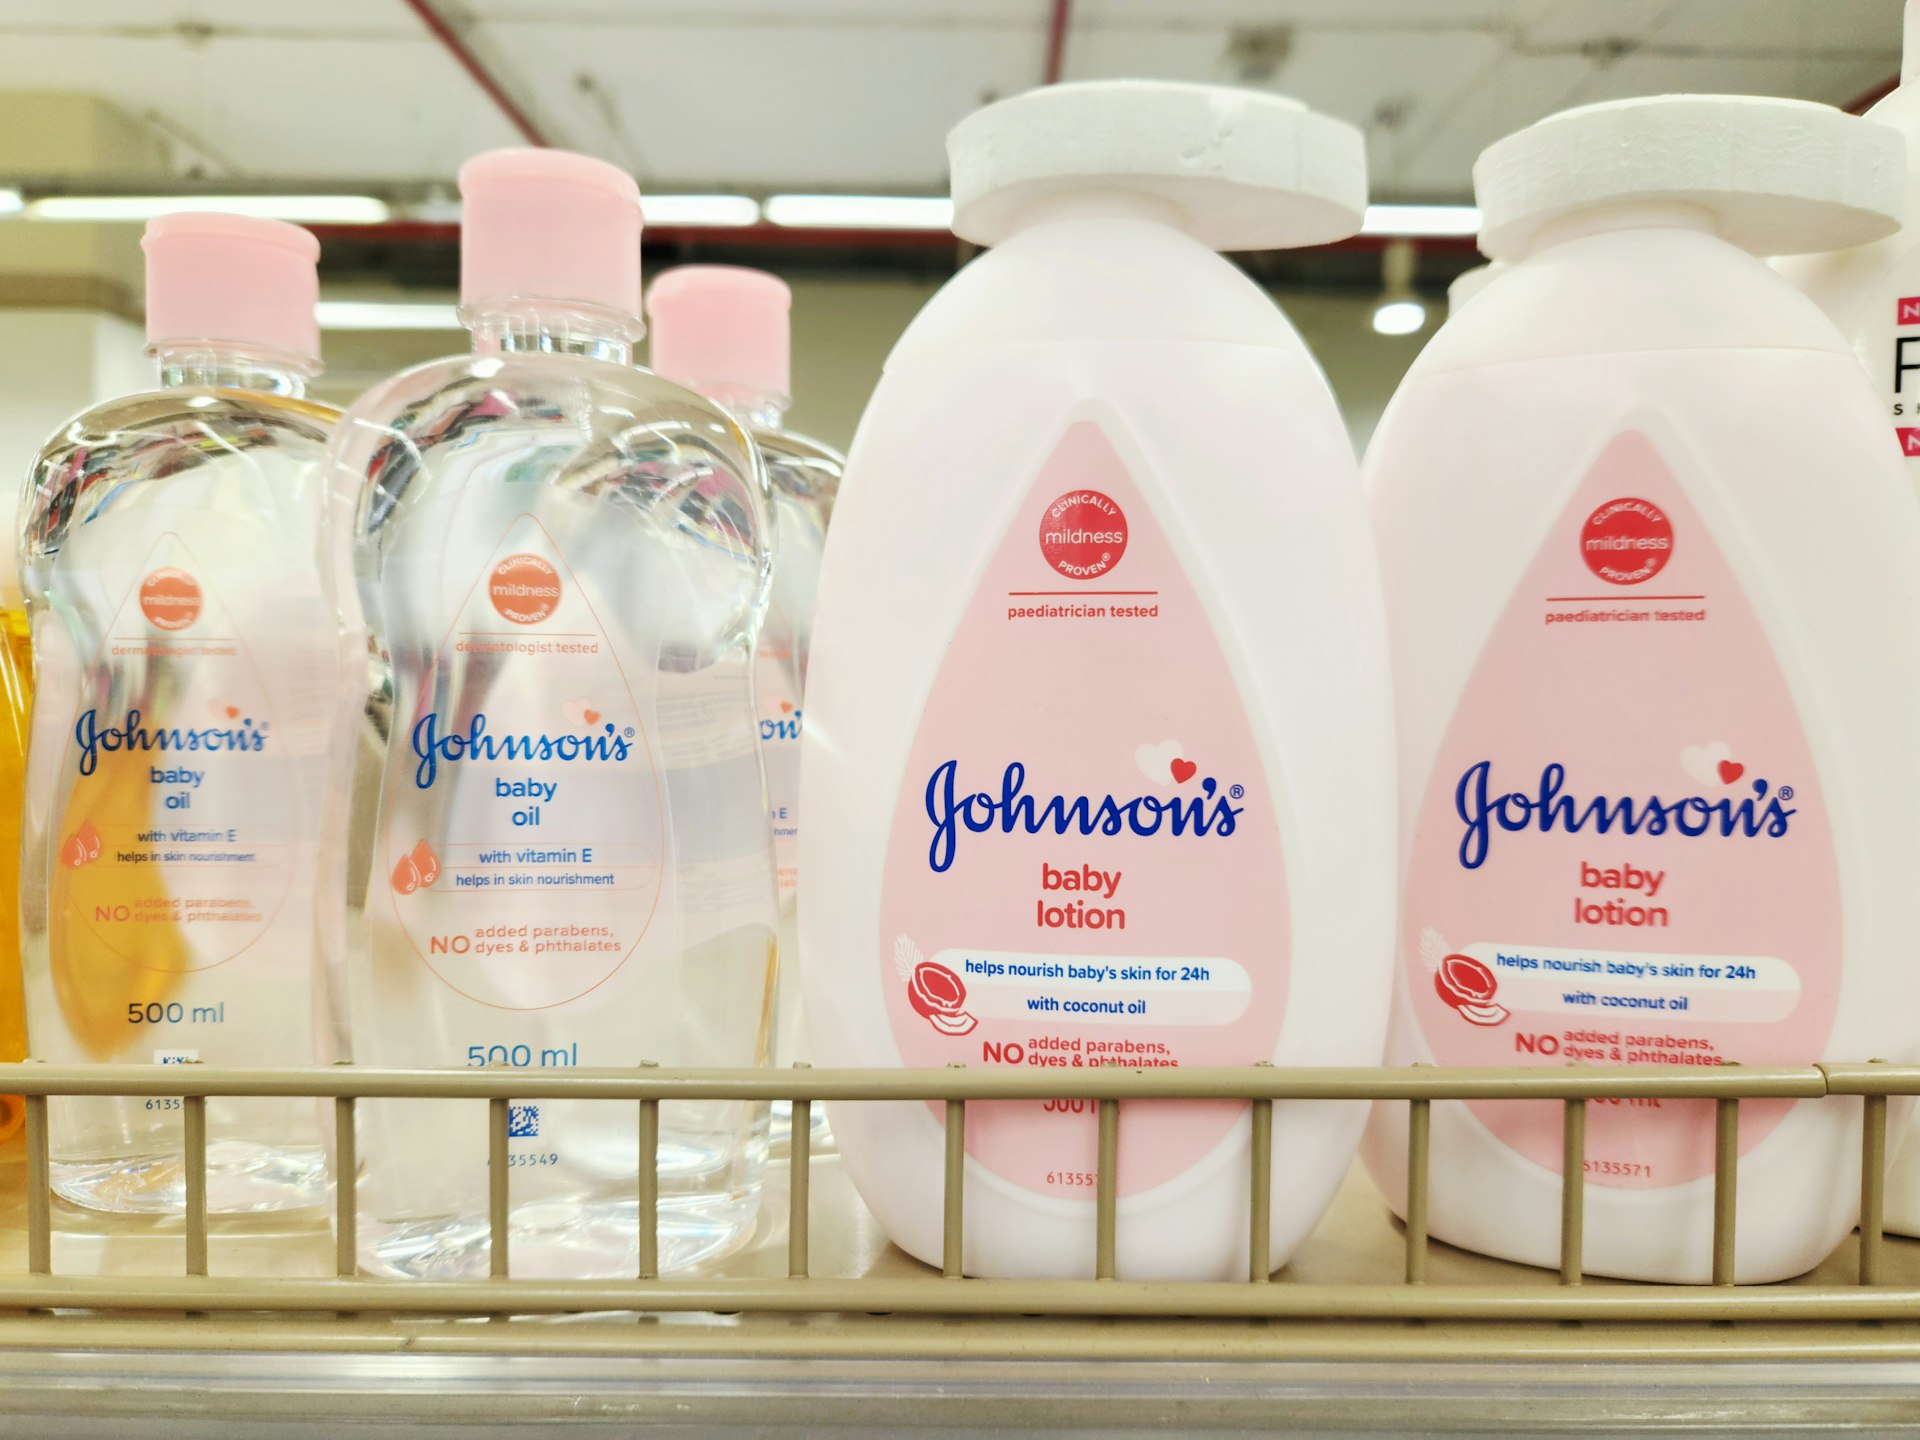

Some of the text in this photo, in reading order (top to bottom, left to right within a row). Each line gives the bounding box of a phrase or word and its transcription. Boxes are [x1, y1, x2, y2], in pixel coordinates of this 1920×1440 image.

[1051, 494, 1117, 518] CLINICALLY
[1592, 502, 1663, 526] CLINICALLY
[1045, 529, 1123, 544] mildness
[1586, 535, 1669, 551] mildness
[498, 556, 553, 576] CLINICALLY
[493, 584, 559, 598] mildness
[1007, 604, 1159, 620] paediatrician tested
[1545, 610, 1705, 625] paediatrician tested
[456, 641, 598, 655] dermatologist tested
[150, 766, 204, 788] baby
[495, 777, 557, 802] baby
[166, 792, 190, 809] oil
[512, 806, 540, 827] oil
[137, 830, 237, 842] with vitamin E
[117, 852, 256, 863] helps in skin nourishment
[479, 848, 592, 863] with vitamin E
[456, 873, 615, 888] helps in skin nourishment
[1042, 863, 1122, 898] baby
[1580, 861, 1665, 896] baby
[134, 898, 181, 908] added
[95, 906, 130, 922] NO
[134, 911, 168, 923] dyes
[173, 911, 182, 921] &
[1037, 900, 1125, 929] lotion
[1574, 898, 1668, 927] lotion
[475, 925, 614, 940] added parabens,
[430, 936, 470, 954] NO
[475, 940, 621, 956] dyes & phthalates
[965, 959, 1210, 982] helps nourish baby's skin for 24h
[1496, 953, 1756, 979] helps nourish baby's skin for 24h
[1027, 997, 1146, 1014] with coconut oil
[1563, 990, 1688, 1010] with coconut oil
[128, 1003, 225, 1023] 500 ml
[1028, 1036, 1171, 1056] added parabens,
[1515, 1032, 1559, 1056] NO
[1563, 1028, 1715, 1052] added parabens,
[468, 1042, 577, 1067] 500 ml
[983, 1041, 1024, 1064] NO
[1028, 1052, 1067, 1067] dyes
[1072, 1054, 1083, 1067] &
[1563, 1045, 1722, 1066] dyes & phthalates
[145, 1099, 184, 1110] 6135
[488, 1153, 558, 1167] 35549
[1046, 1171, 1098, 1186] 61355
